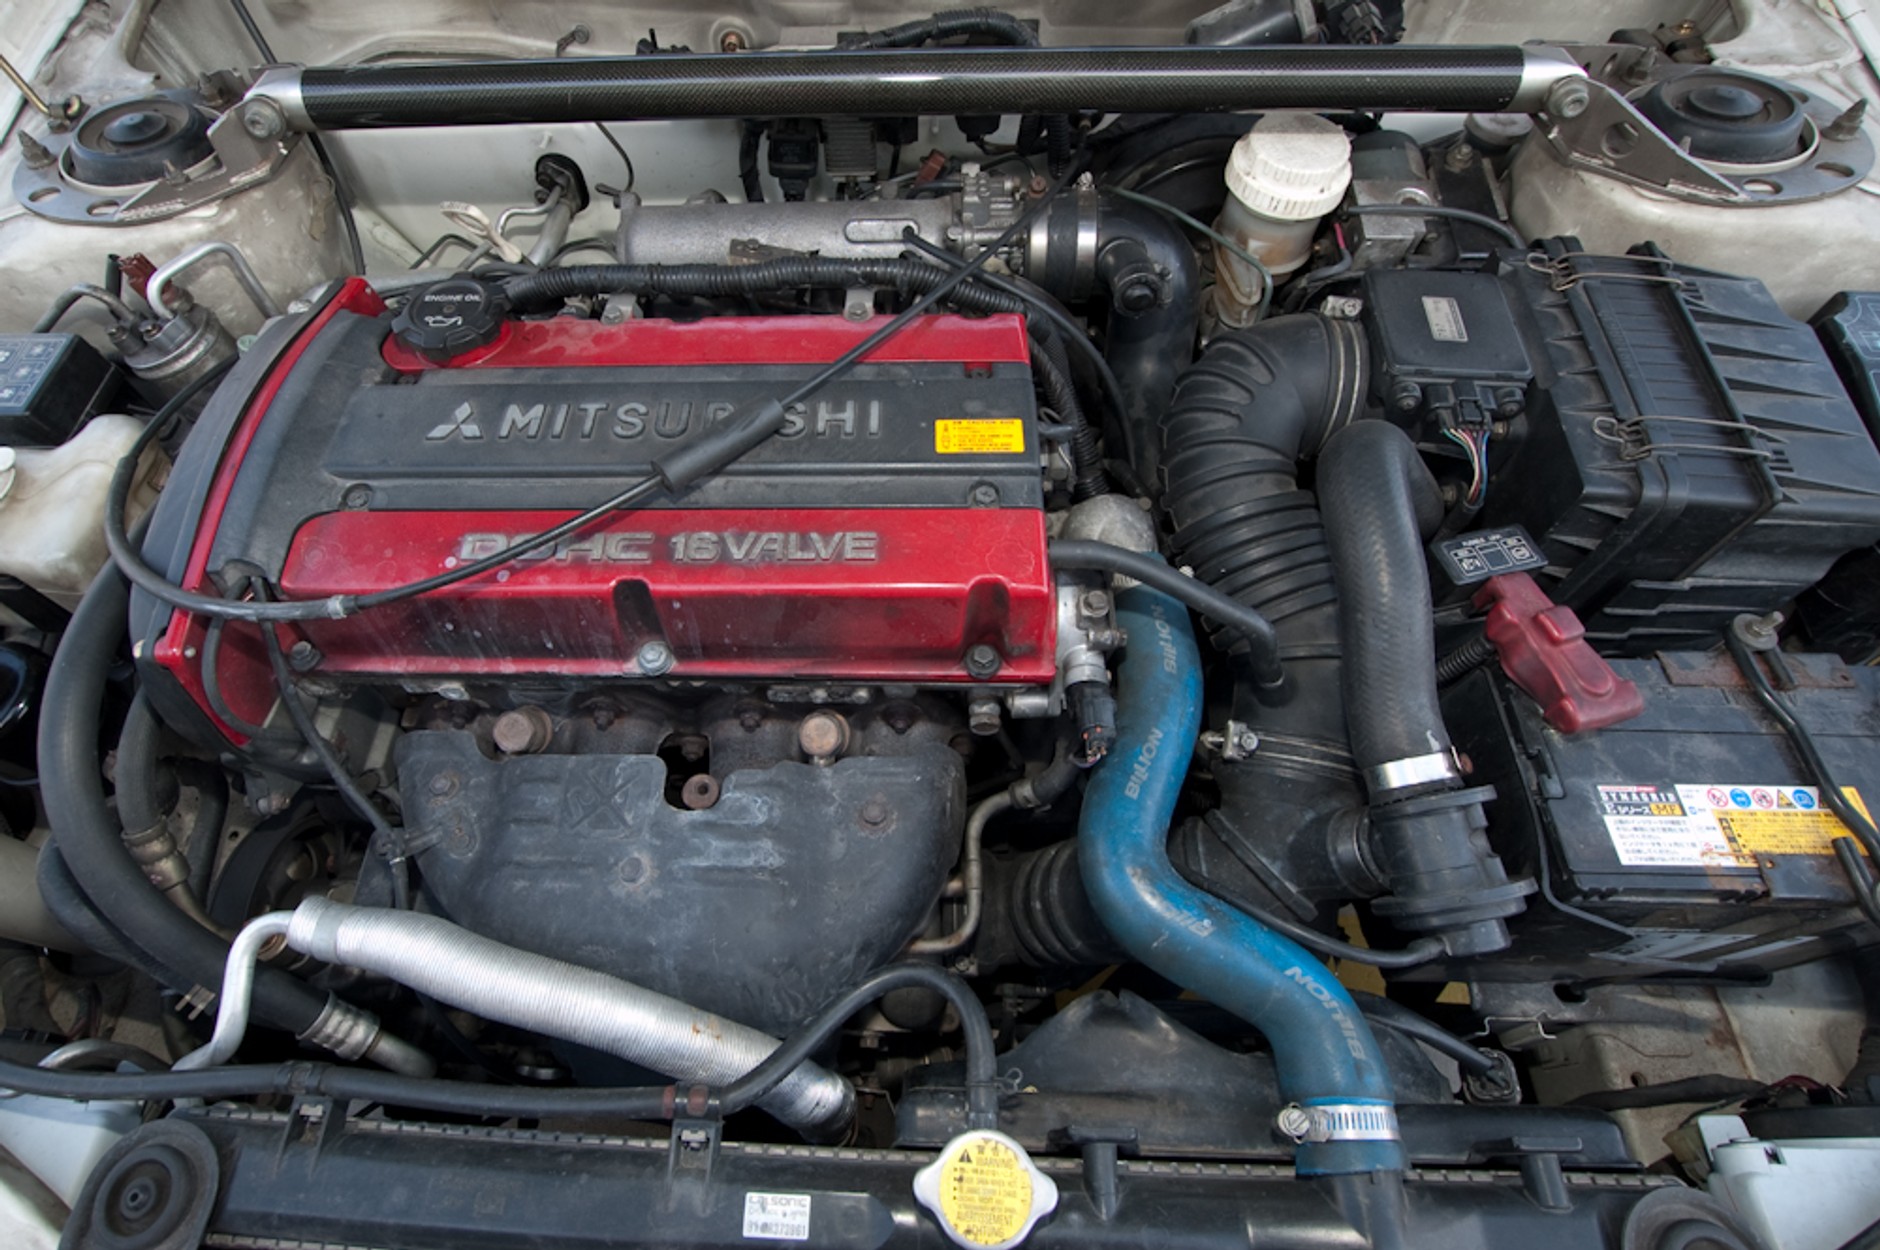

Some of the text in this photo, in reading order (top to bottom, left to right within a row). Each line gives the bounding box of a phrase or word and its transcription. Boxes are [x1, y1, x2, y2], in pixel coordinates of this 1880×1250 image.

[424, 293, 481, 302] ENGINE OIL
[1124, 727, 1164, 800] BILLION
[1284, 965, 1367, 1060] BILLION
